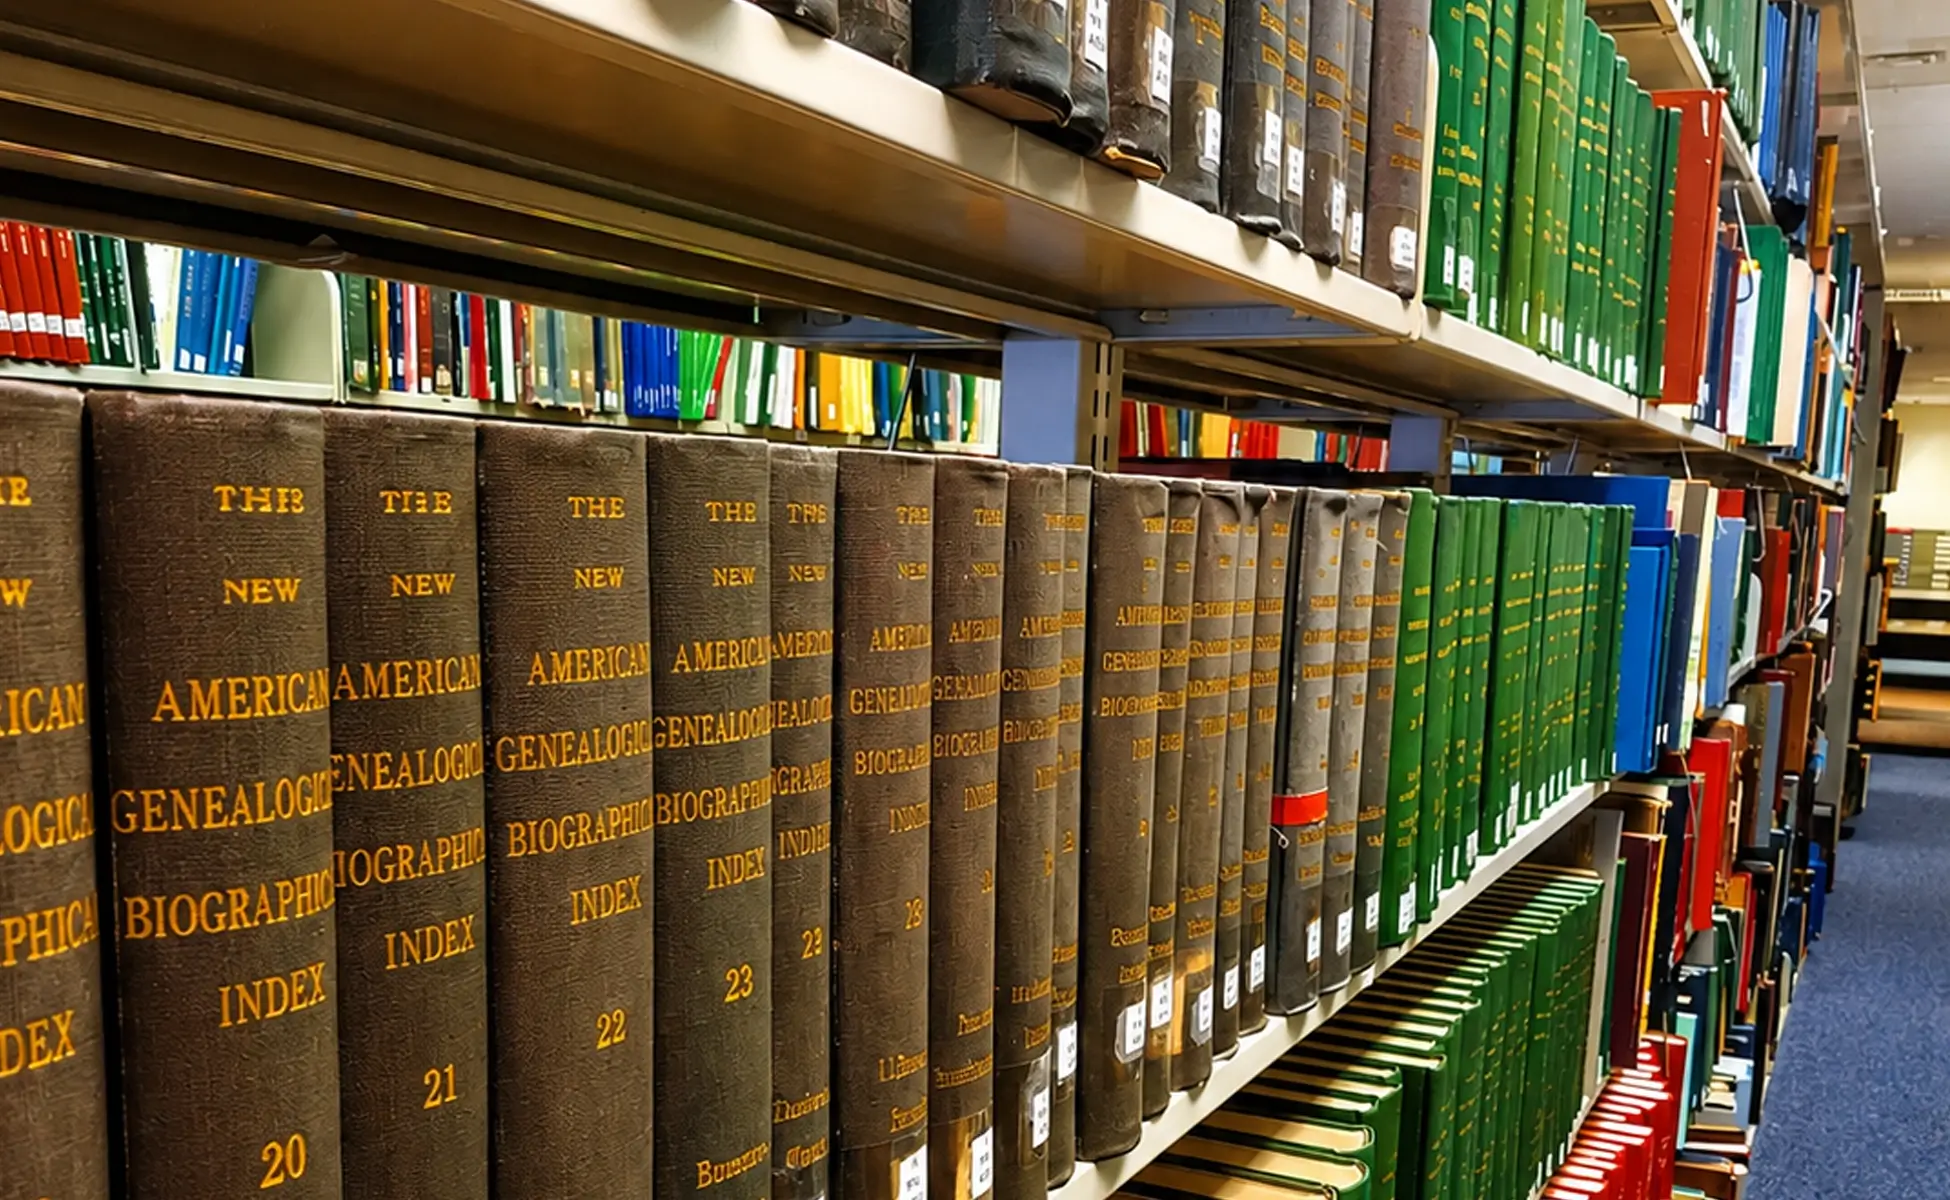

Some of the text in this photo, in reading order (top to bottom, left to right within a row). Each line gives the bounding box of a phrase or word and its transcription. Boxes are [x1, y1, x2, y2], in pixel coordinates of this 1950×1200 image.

[570, 497, 625, 518] THE
[706, 501, 756, 522] THE
[223, 578, 302, 604] NEW
[391, 573, 455, 597] NEW
[574, 567, 623, 589] NEW
[713, 567, 755, 586] NEW
[707, 848, 765, 889] INDEX
[570, 875, 642, 925] INDEX
[386, 915, 475, 969] INDEX
[220, 962, 326, 1027] INDEX
[725, 964, 753, 1002] 23
[597, 1009, 626, 1049] 22
[424, 1064, 455, 1108] 21
[260, 1134, 306, 1188] 20
